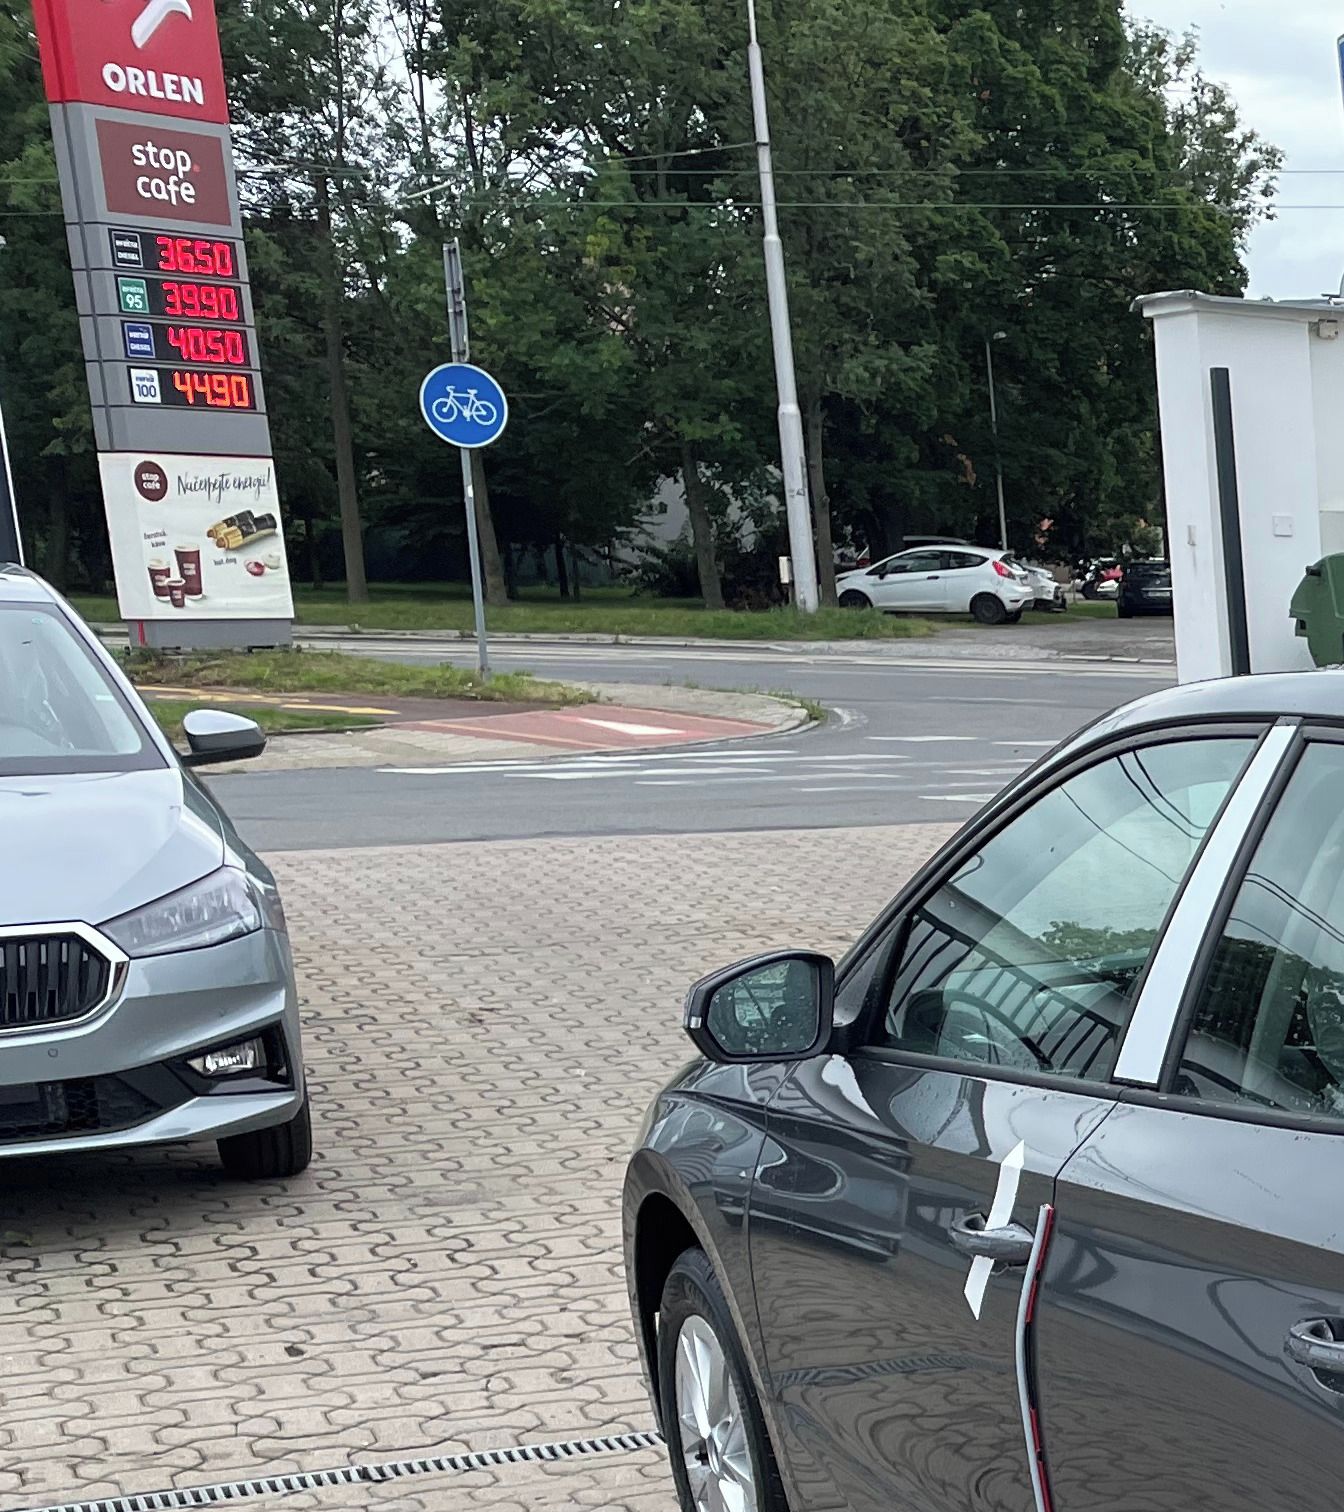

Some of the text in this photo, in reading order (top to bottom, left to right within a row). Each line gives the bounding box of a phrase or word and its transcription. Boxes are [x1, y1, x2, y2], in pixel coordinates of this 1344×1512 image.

[102, 62, 204, 105] ORLEN
[136, 175, 196, 205] cafe
[126, 294, 143, 308] 95
[136, 384, 157, 398] 100
